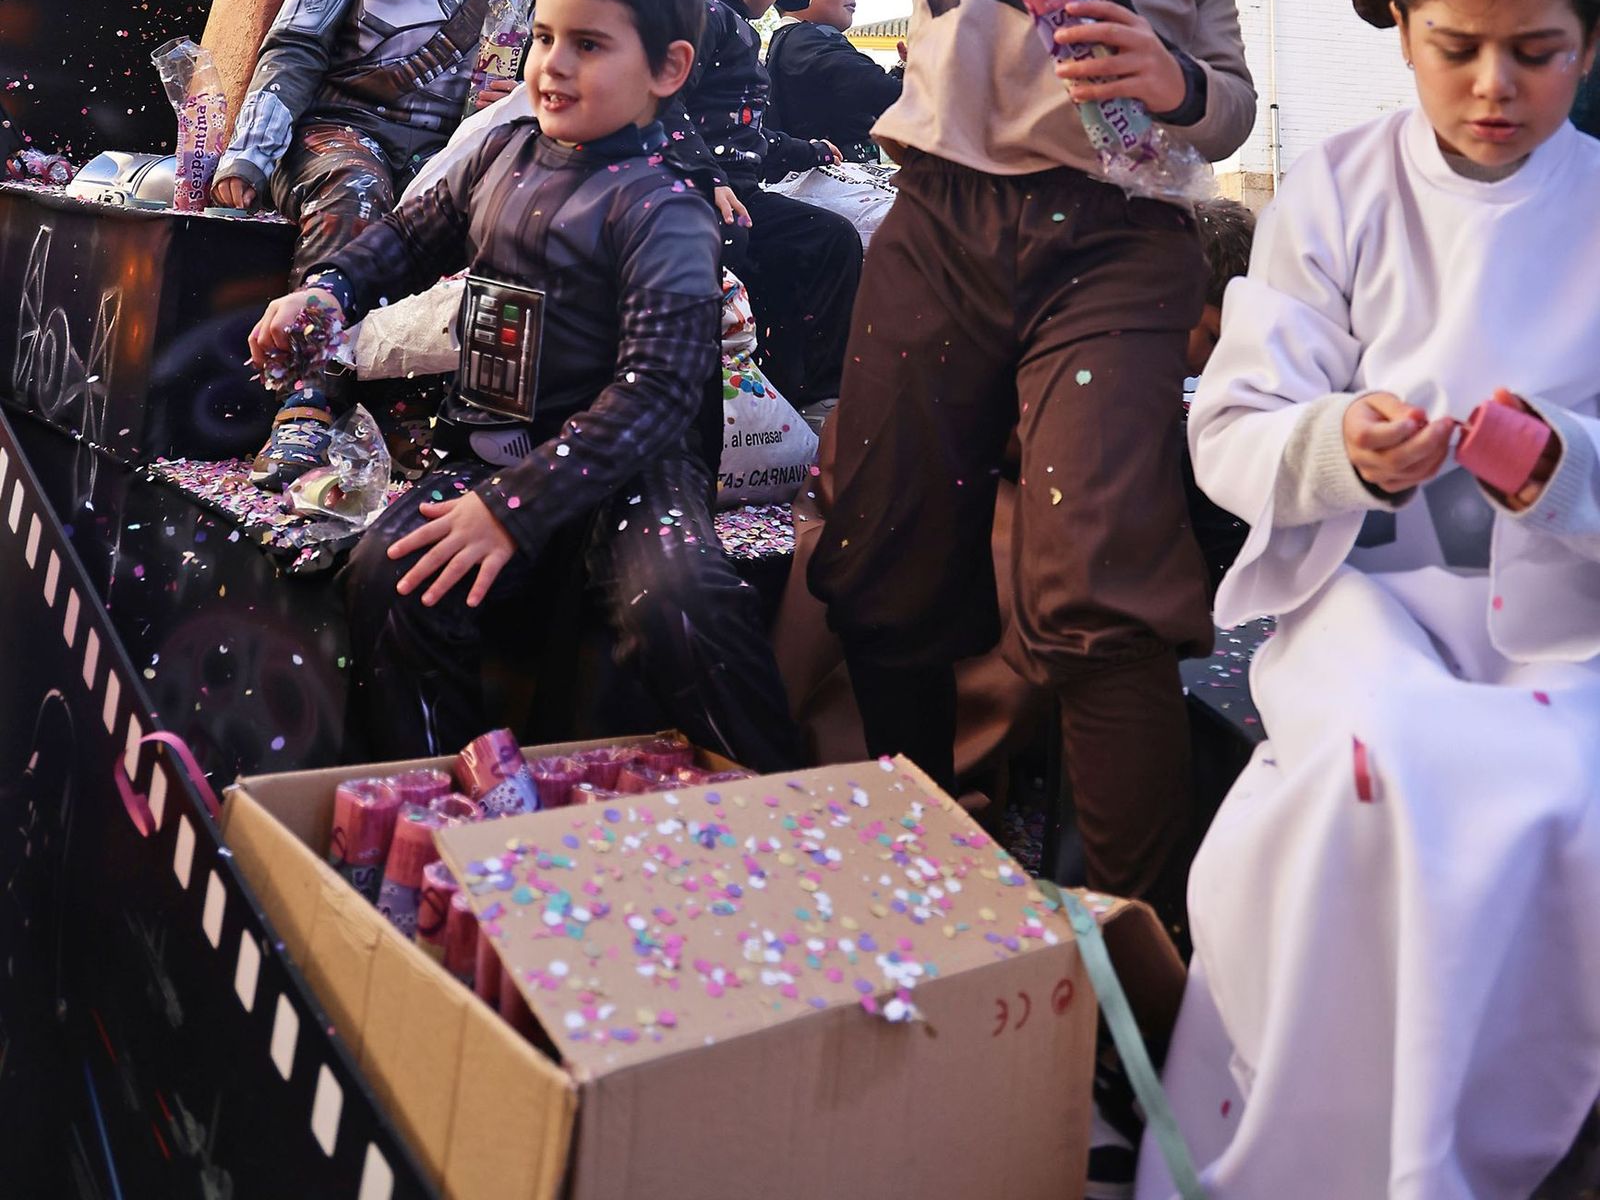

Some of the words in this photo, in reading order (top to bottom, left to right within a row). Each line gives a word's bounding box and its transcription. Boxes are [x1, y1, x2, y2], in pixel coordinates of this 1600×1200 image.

[189, 104, 208, 200] Serpentina
[731, 430, 742, 448] al
[745, 430, 783, 447] envasar
[748, 463, 810, 487] CARNAVA
